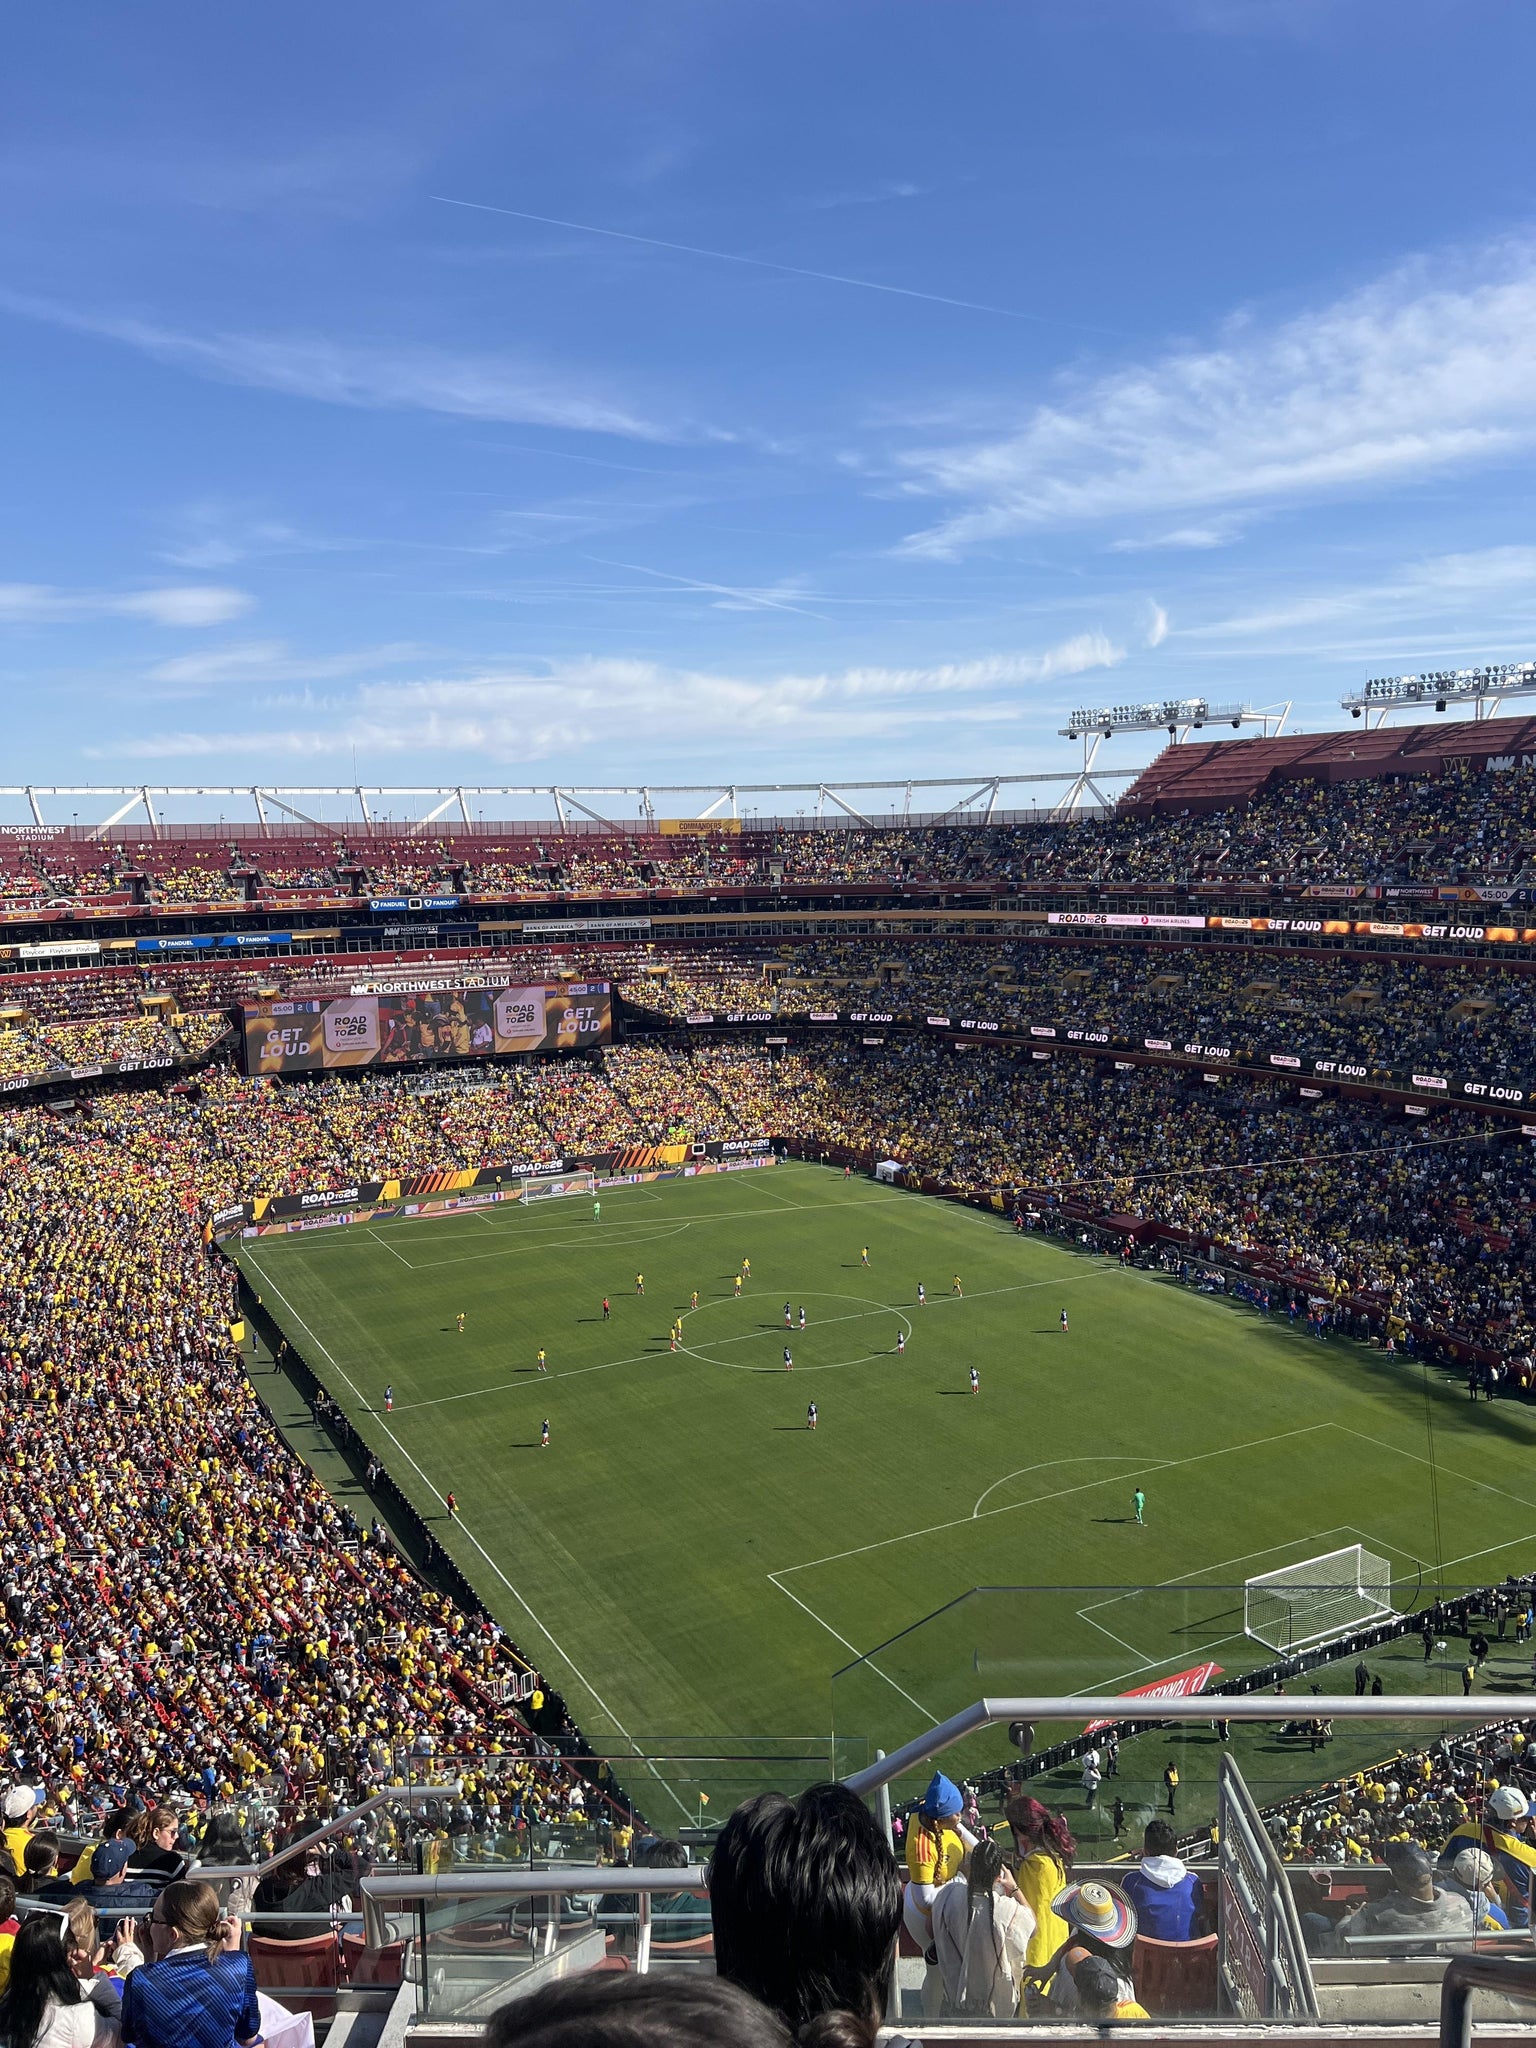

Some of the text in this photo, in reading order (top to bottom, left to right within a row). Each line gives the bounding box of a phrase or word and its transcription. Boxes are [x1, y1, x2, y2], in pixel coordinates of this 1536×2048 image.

[1, 826, 66, 835] NORTHWEST
[679, 822, 722, 830] COMMANDERS
[1465, 890, 1471, 898] 0
[1519, 891, 1526, 900] 2
[1268, 919, 1322, 931] GET LOUD
[1423, 926, 1483, 939] GET LOUD
[373, 980, 450, 992] NORTHWEST
[454, 976, 509, 987] STADIUM
[505, 1004, 534, 1014] ROAD
[563, 1007, 594, 1019] GET
[335, 1016, 366, 1025] ROAD
[517, 1012, 534, 1023] 26
[727, 1013, 772, 1022] GET LOUD
[347, 1024, 367, 1035] 26
[557, 1020, 600, 1034] LOUD
[961, 1020, 998, 1031] GET LOUD
[267, 1028, 303, 1043] GET
[1068, 1030, 1108, 1043] GET LOUD
[260, 1042, 310, 1058] LOUD
[1184, 1044, 1230, 1057] GET LOUD
[119, 1058, 173, 1072] GET LOUD
[1315, 1061, 1367, 1077] GET LOUD
[3, 1078, 29, 1091] LOUD
[1464, 1082, 1523, 1101] GET LOUD
[723, 1141, 750, 1150] ROAD
[512, 1163, 541, 1173] ROAD
[302, 1192, 335, 1204] ROAD
